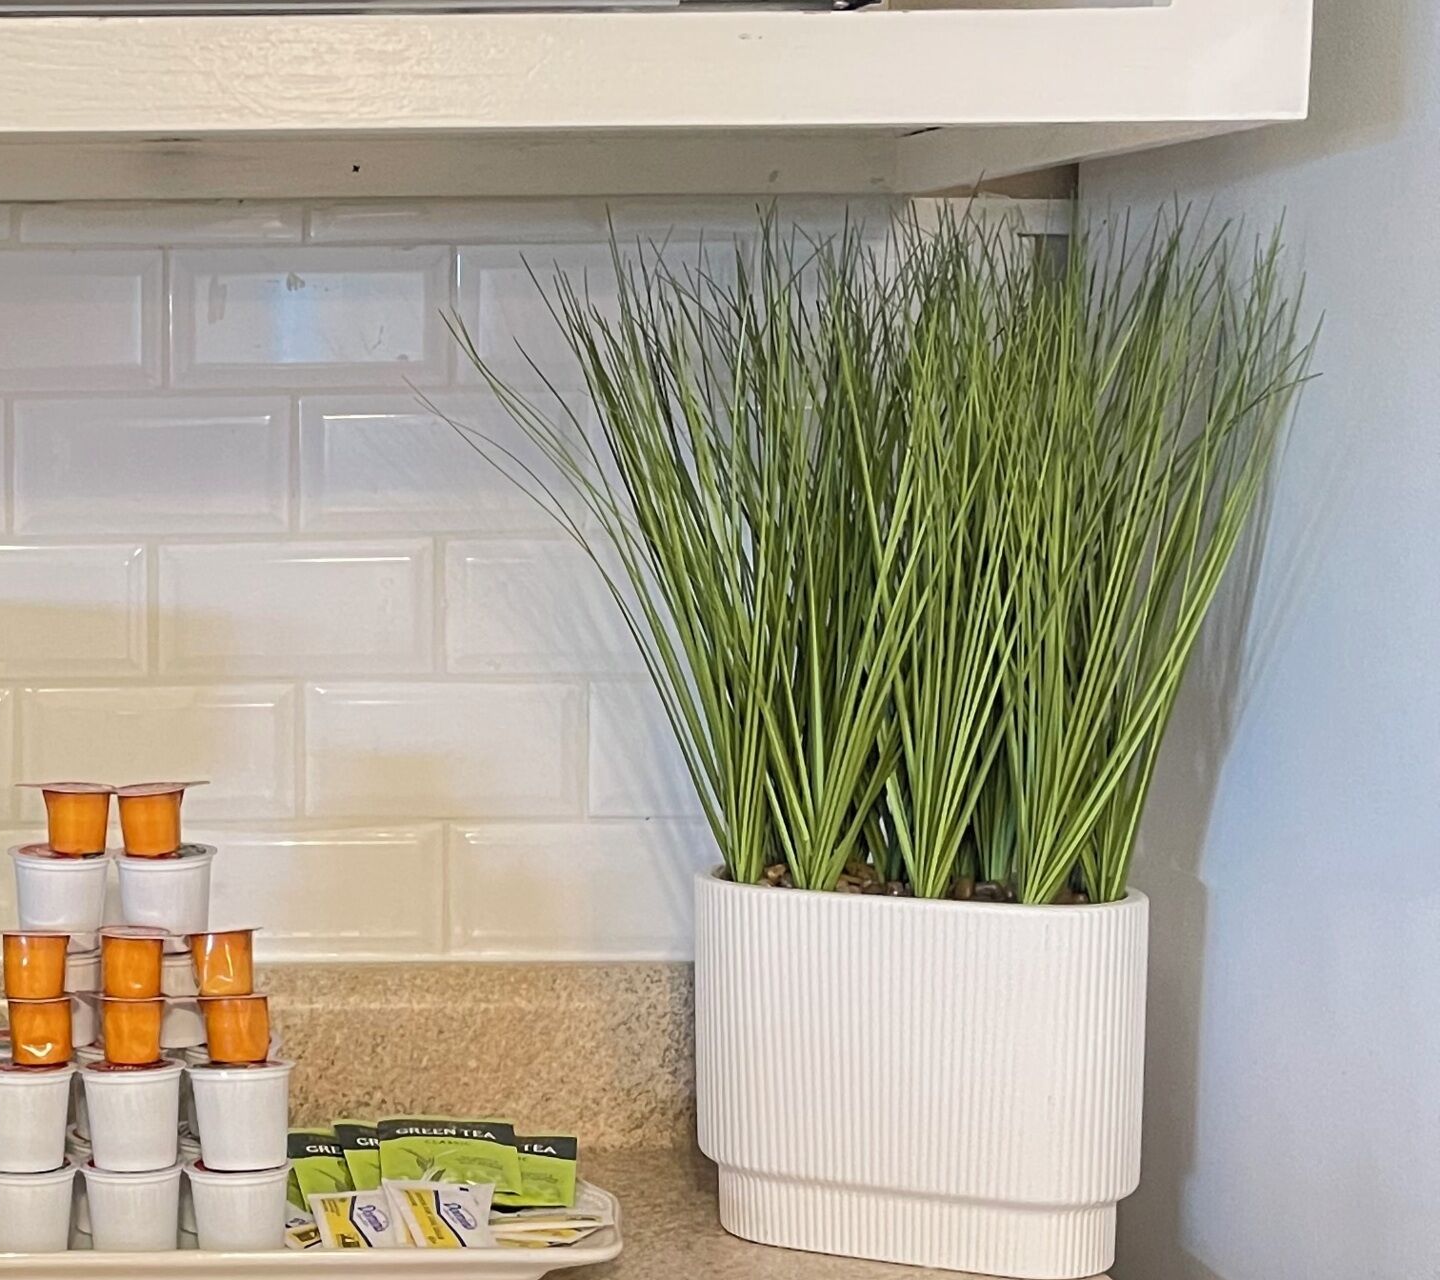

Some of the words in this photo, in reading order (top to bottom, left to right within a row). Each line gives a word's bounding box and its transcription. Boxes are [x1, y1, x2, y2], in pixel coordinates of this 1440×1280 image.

[395, 1127, 457, 1136] GREEN
[462, 1128, 497, 1140] TEA
[522, 1143, 558, 1155] TEA
